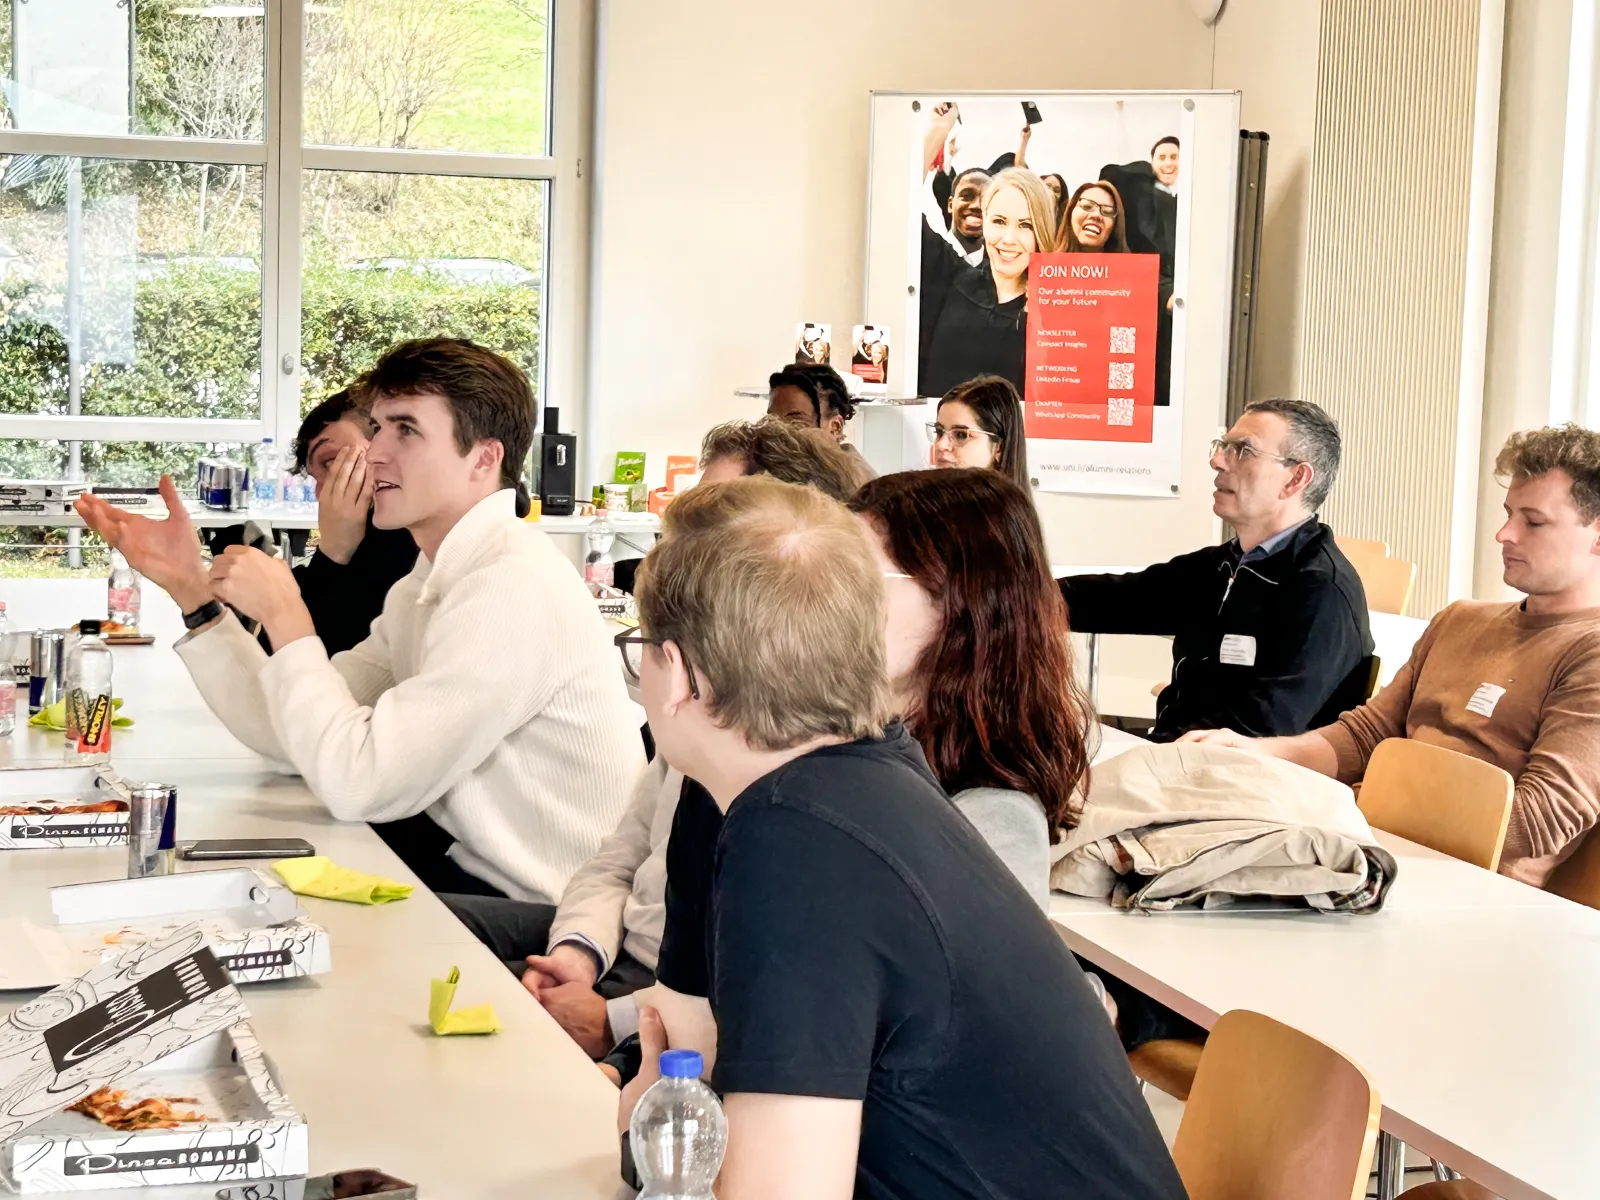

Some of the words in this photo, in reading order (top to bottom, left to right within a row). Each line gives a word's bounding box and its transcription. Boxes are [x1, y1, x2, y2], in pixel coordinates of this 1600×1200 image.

[1039, 265, 1067, 278] JOIN
[1071, 265, 1109, 279] NOW!
[1038, 287, 1053, 295] Our
[1056, 288, 1083, 296] alumni
[1085, 289, 1131, 298] community
[1038, 297, 1050, 305] for
[1072, 298, 1097, 306] future
[75, 1154, 175, 1175] Pinsa
[178, 1148, 247, 1165] ROMANA
